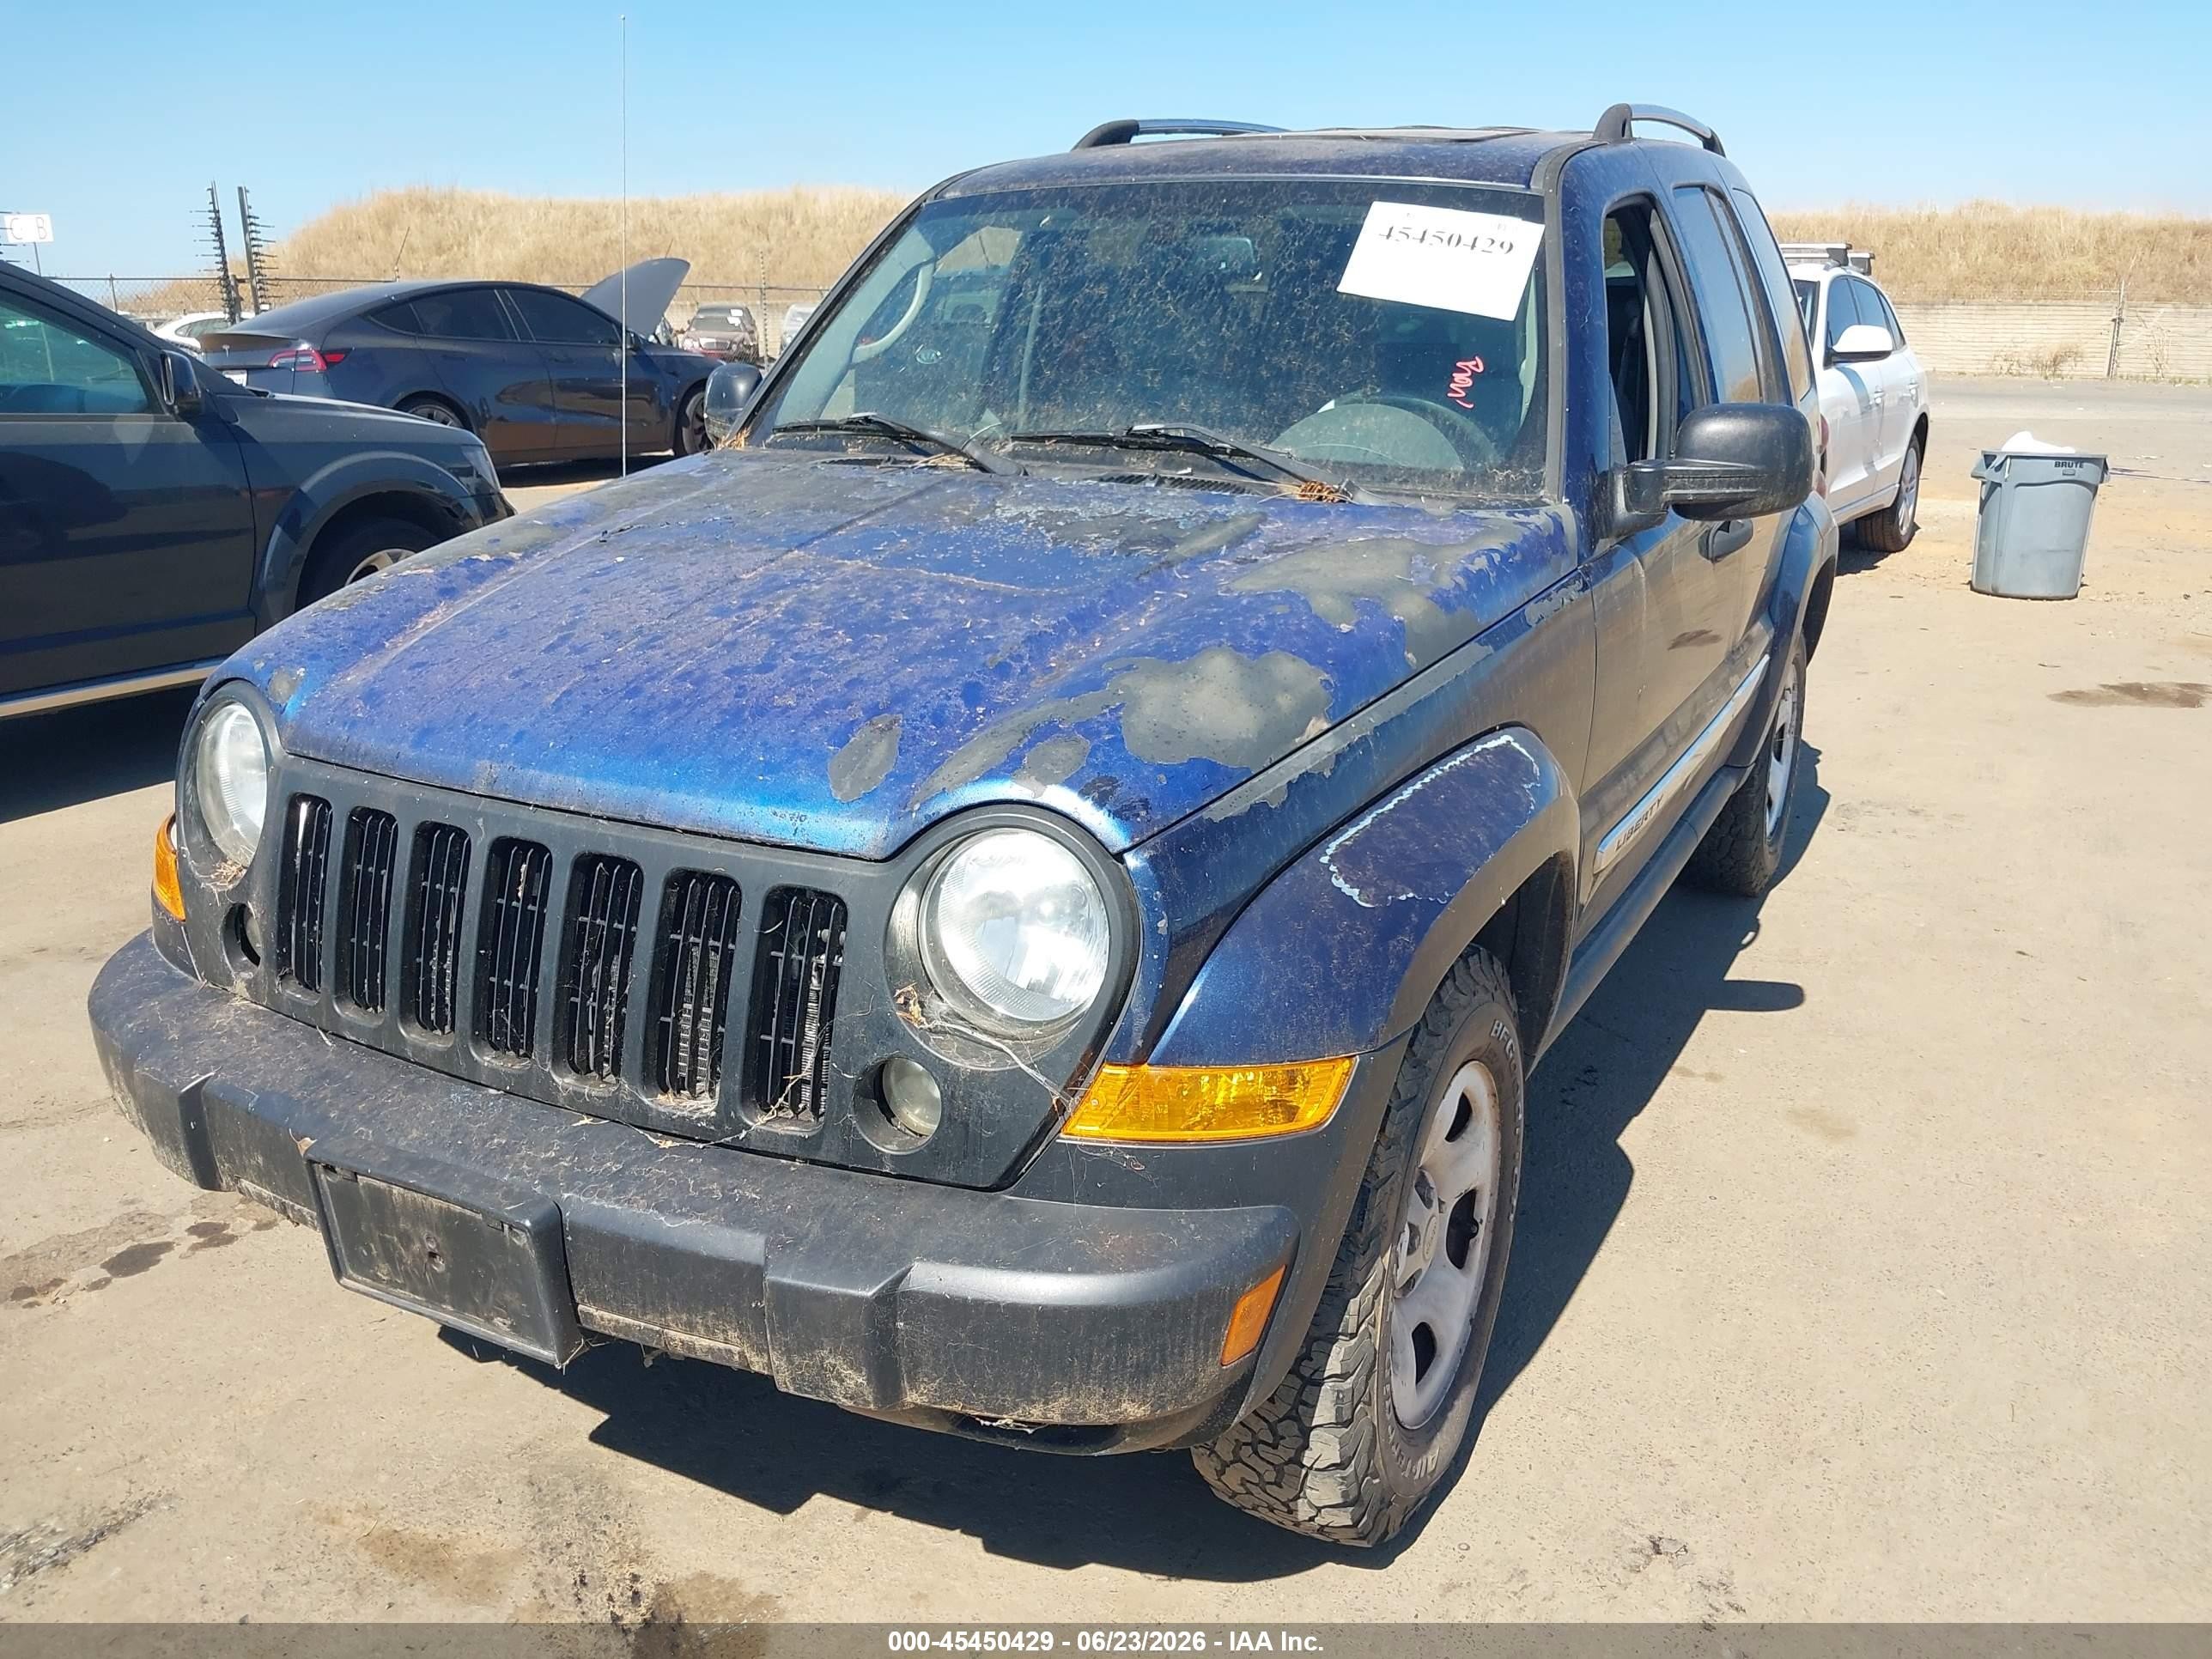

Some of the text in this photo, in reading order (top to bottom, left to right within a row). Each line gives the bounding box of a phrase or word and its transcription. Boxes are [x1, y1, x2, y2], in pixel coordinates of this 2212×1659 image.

[35, 216, 48, 240] B
[1378, 225, 1514, 255] 45450429
[2054, 460, 2084, 469] BRUTE
[1615, 793, 1664, 852] LIBERTY
